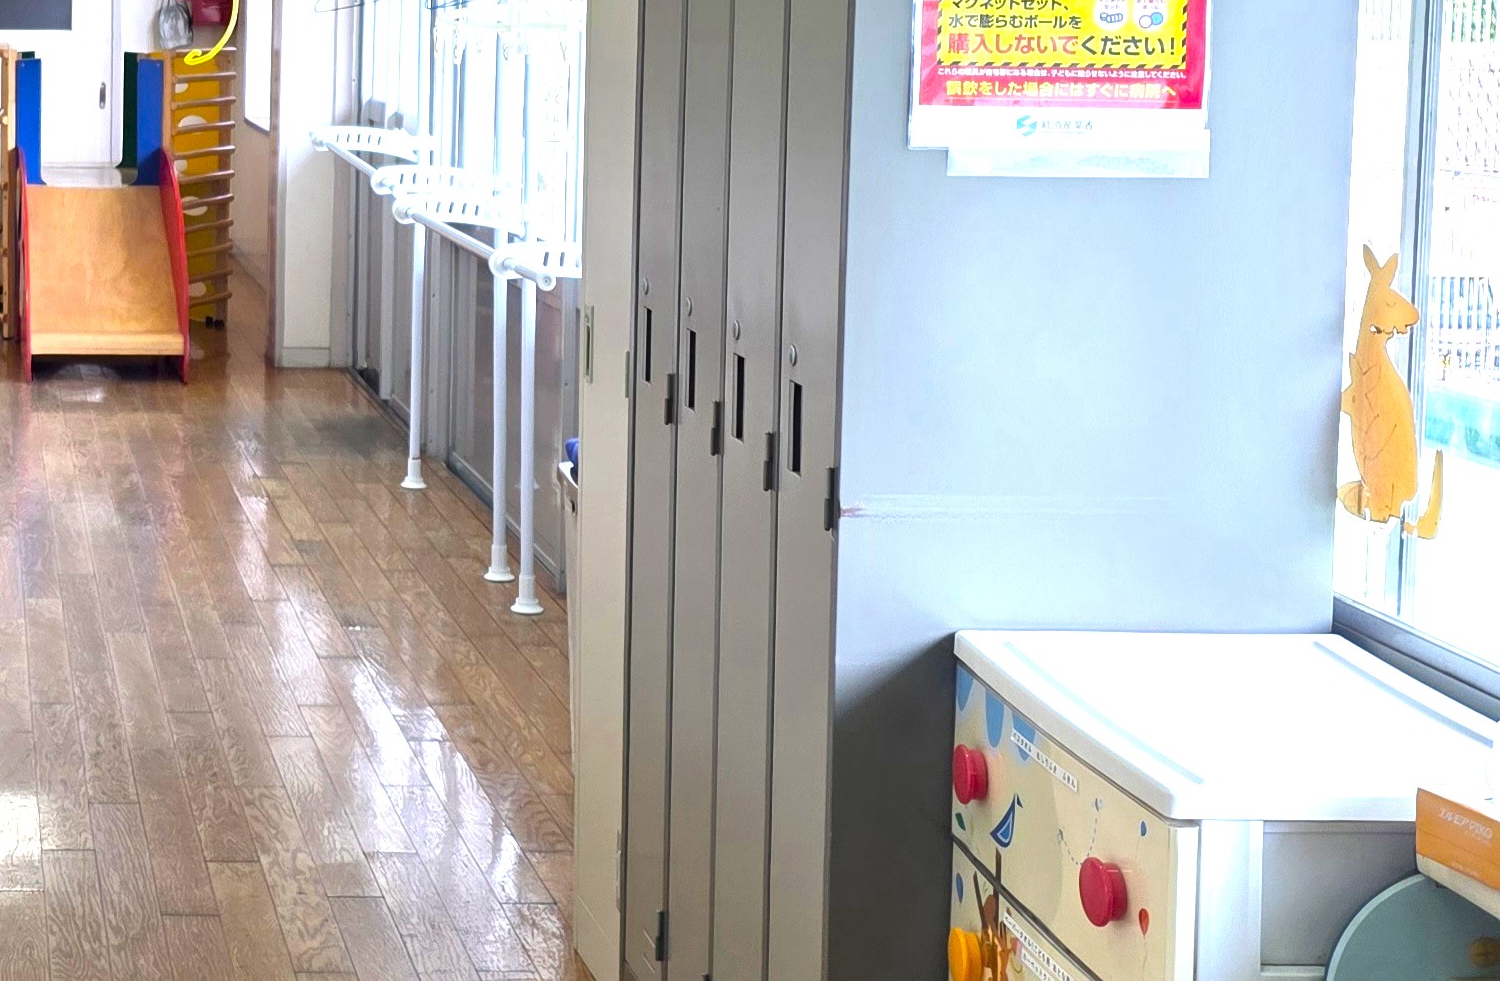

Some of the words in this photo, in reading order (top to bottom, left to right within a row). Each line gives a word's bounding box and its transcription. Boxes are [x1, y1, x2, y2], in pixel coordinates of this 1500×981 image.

[949, 14, 1082, 29] 水で膨らむボールを
